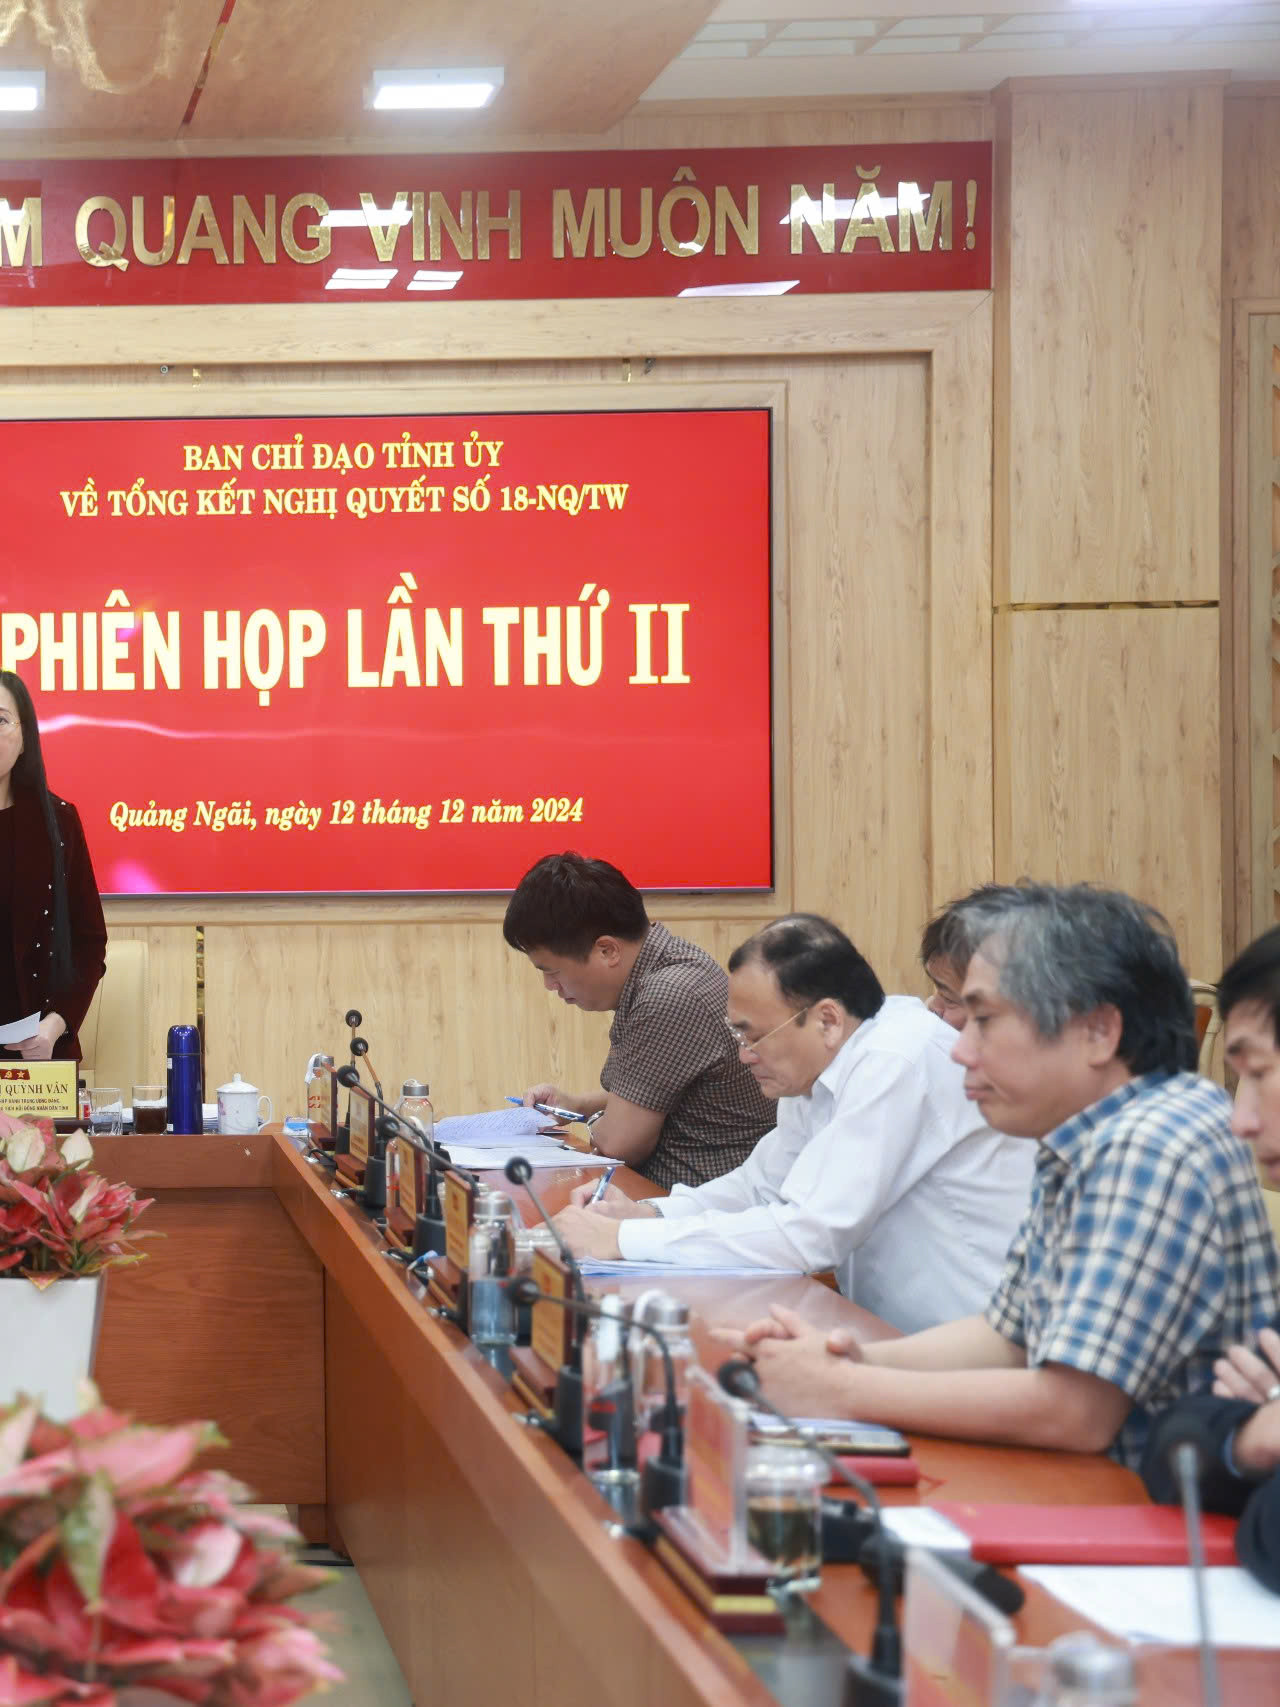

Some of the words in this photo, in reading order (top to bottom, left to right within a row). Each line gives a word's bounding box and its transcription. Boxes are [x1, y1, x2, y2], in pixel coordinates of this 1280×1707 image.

[75, 193, 332, 272] QUANG
[359, 190, 521, 263] VINH
[552, 166, 760, 258] MUÔN
[183, 444, 245, 471] BAN
[251, 432, 305, 471] CHỈ
[312, 442, 375, 476] ĐẠO
[382, 431, 455, 469] TỈNH
[463, 430, 505, 468] ỦY
[59, 479, 99, 518] VỀ
[107, 476, 189, 517] TỔNG
[195, 477, 256, 516] KẾT
[262, 487, 339, 520] NGHỊ
[345, 477, 446, 519] QUYẾT
[452, 474, 491, 513] SỐ
[500, 482, 631, 516] 18-NQ/TW
[0, 588, 181, 692] PHIÊN
[203, 607, 327, 707] HỌP
[347, 571, 464, 688] LẦN
[482, 583, 611, 687] THỨ
[628, 603, 691, 685] II
[109, 799, 189, 834] Quảng
[193, 799, 257, 832] Ngãi,
[264, 799, 322, 832] ngày
[329, 800, 356, 825] 12
[361, 798, 433, 831] tháng
[438, 799, 465, 824] 12
[471, 798, 525, 824] năm
[529, 797, 584, 823] 2024
[5, 1083, 42, 1096] QUỲNH
